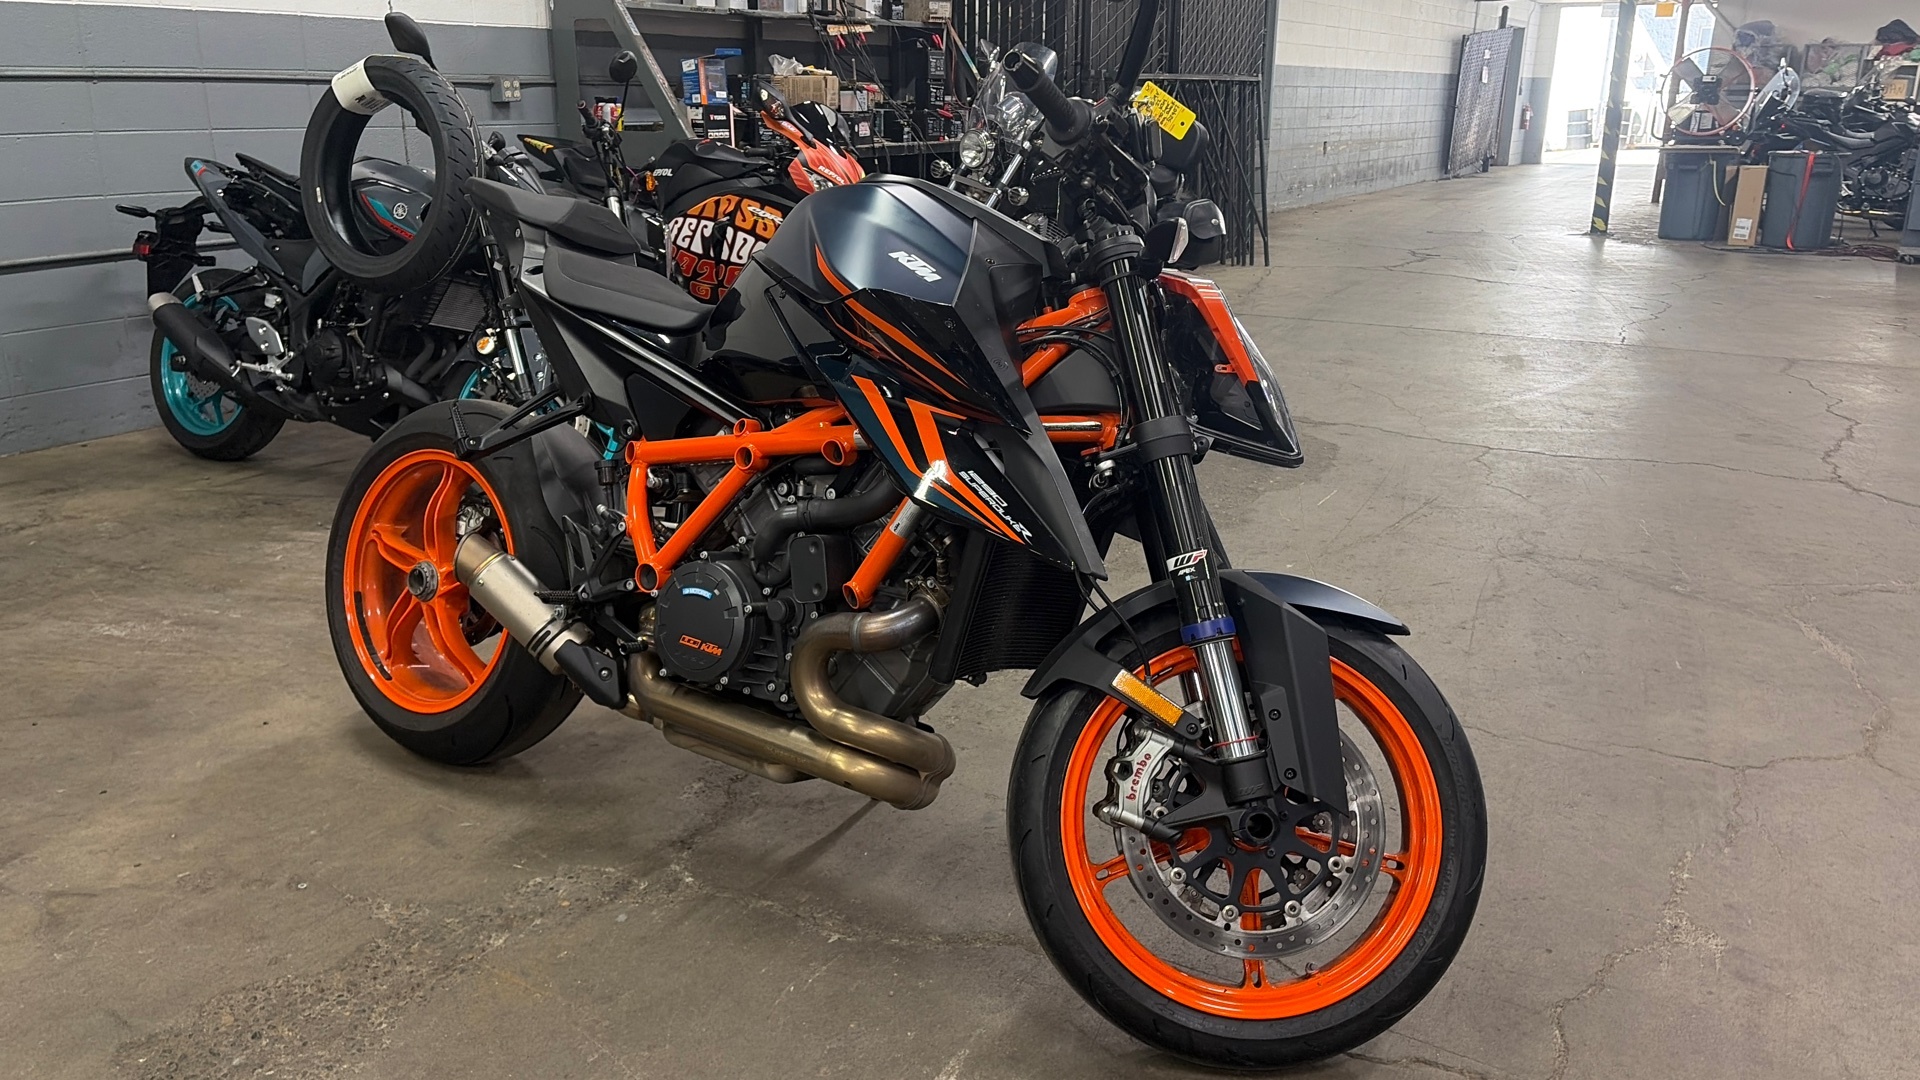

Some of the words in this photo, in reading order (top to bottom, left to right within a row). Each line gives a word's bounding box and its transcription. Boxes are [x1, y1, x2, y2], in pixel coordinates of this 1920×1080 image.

[652, 168, 673, 177] EPSOL
[817, 165, 845, 186] REPSOL
[887, 250, 942, 282] KTM
[701, 643, 723, 656] KTM
[1125, 752, 1152, 801] brembo
